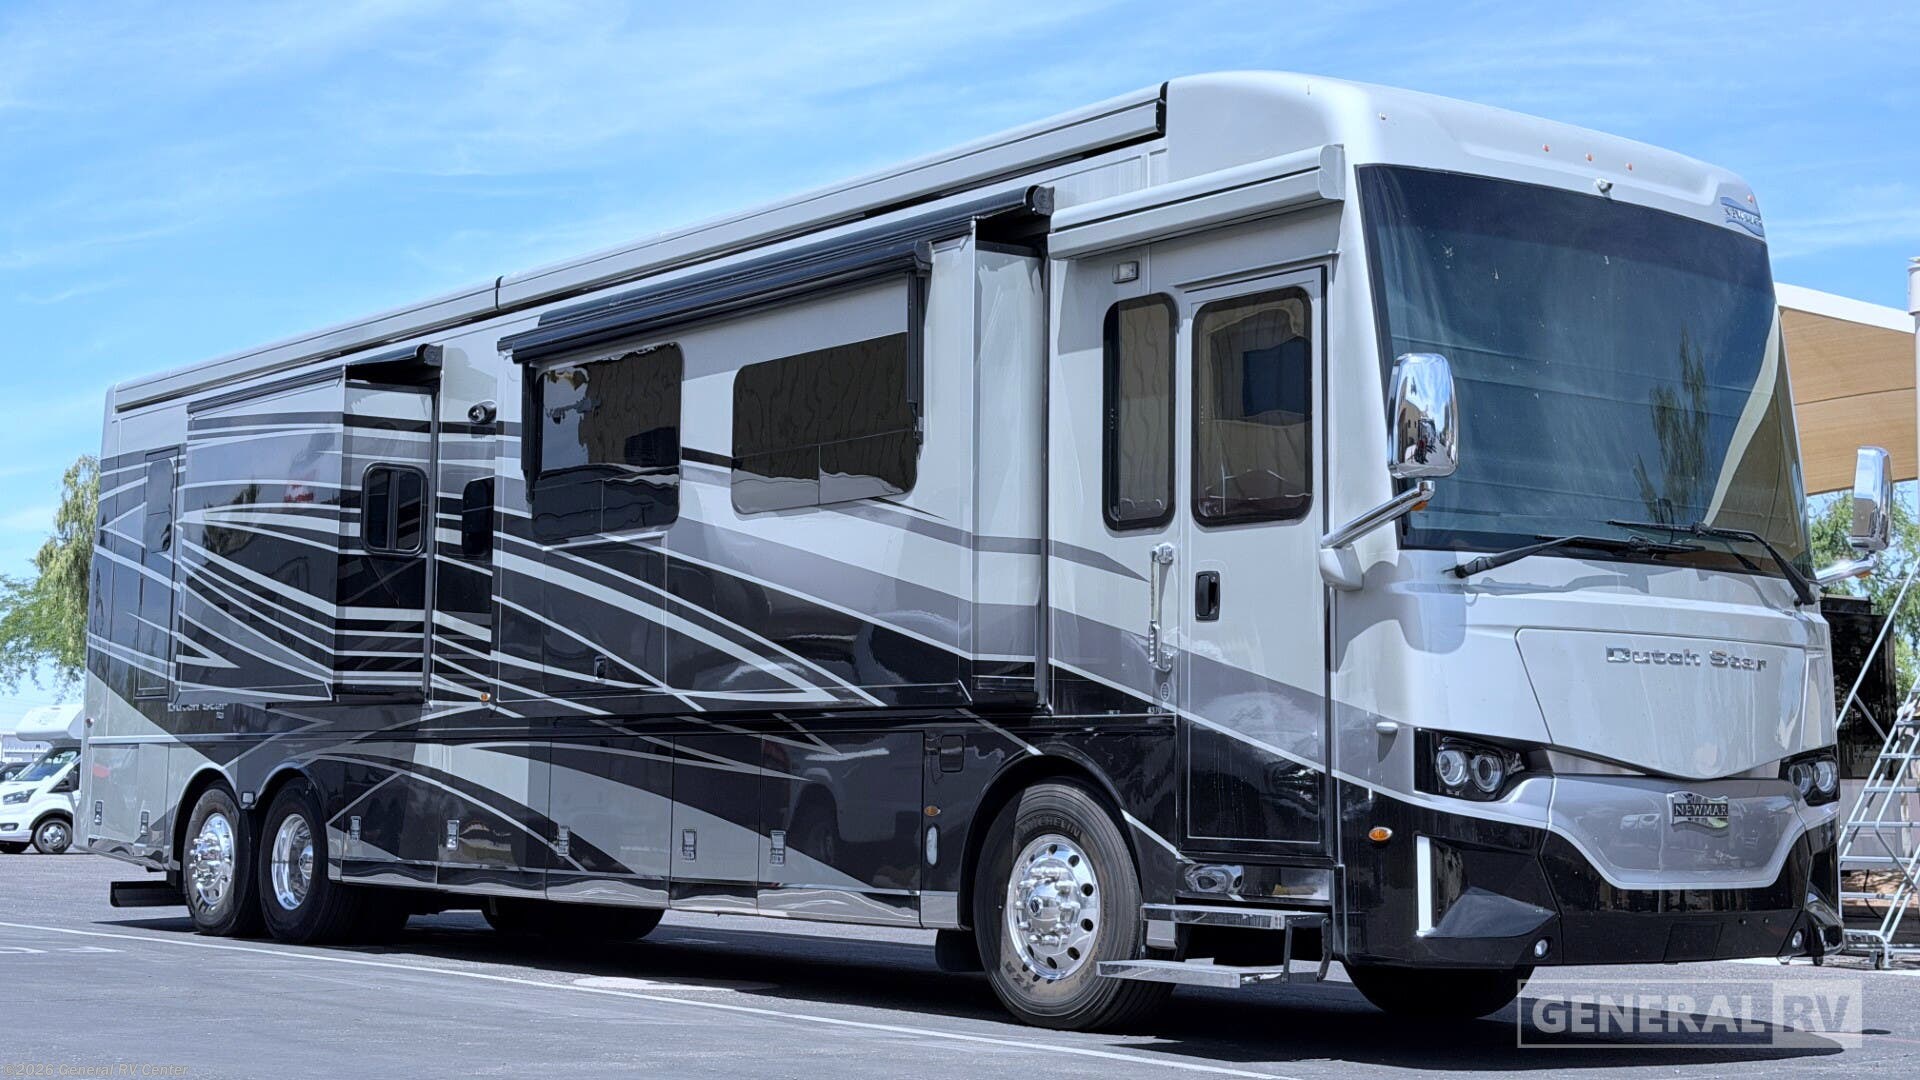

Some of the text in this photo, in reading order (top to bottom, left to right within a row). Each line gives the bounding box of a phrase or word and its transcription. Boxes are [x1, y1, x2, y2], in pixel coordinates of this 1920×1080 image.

[1605, 646, 1768, 672] Dutch Star
[1674, 803, 1729, 816] NEWMAR
[1019, 815, 1081, 838] MICHELIN
